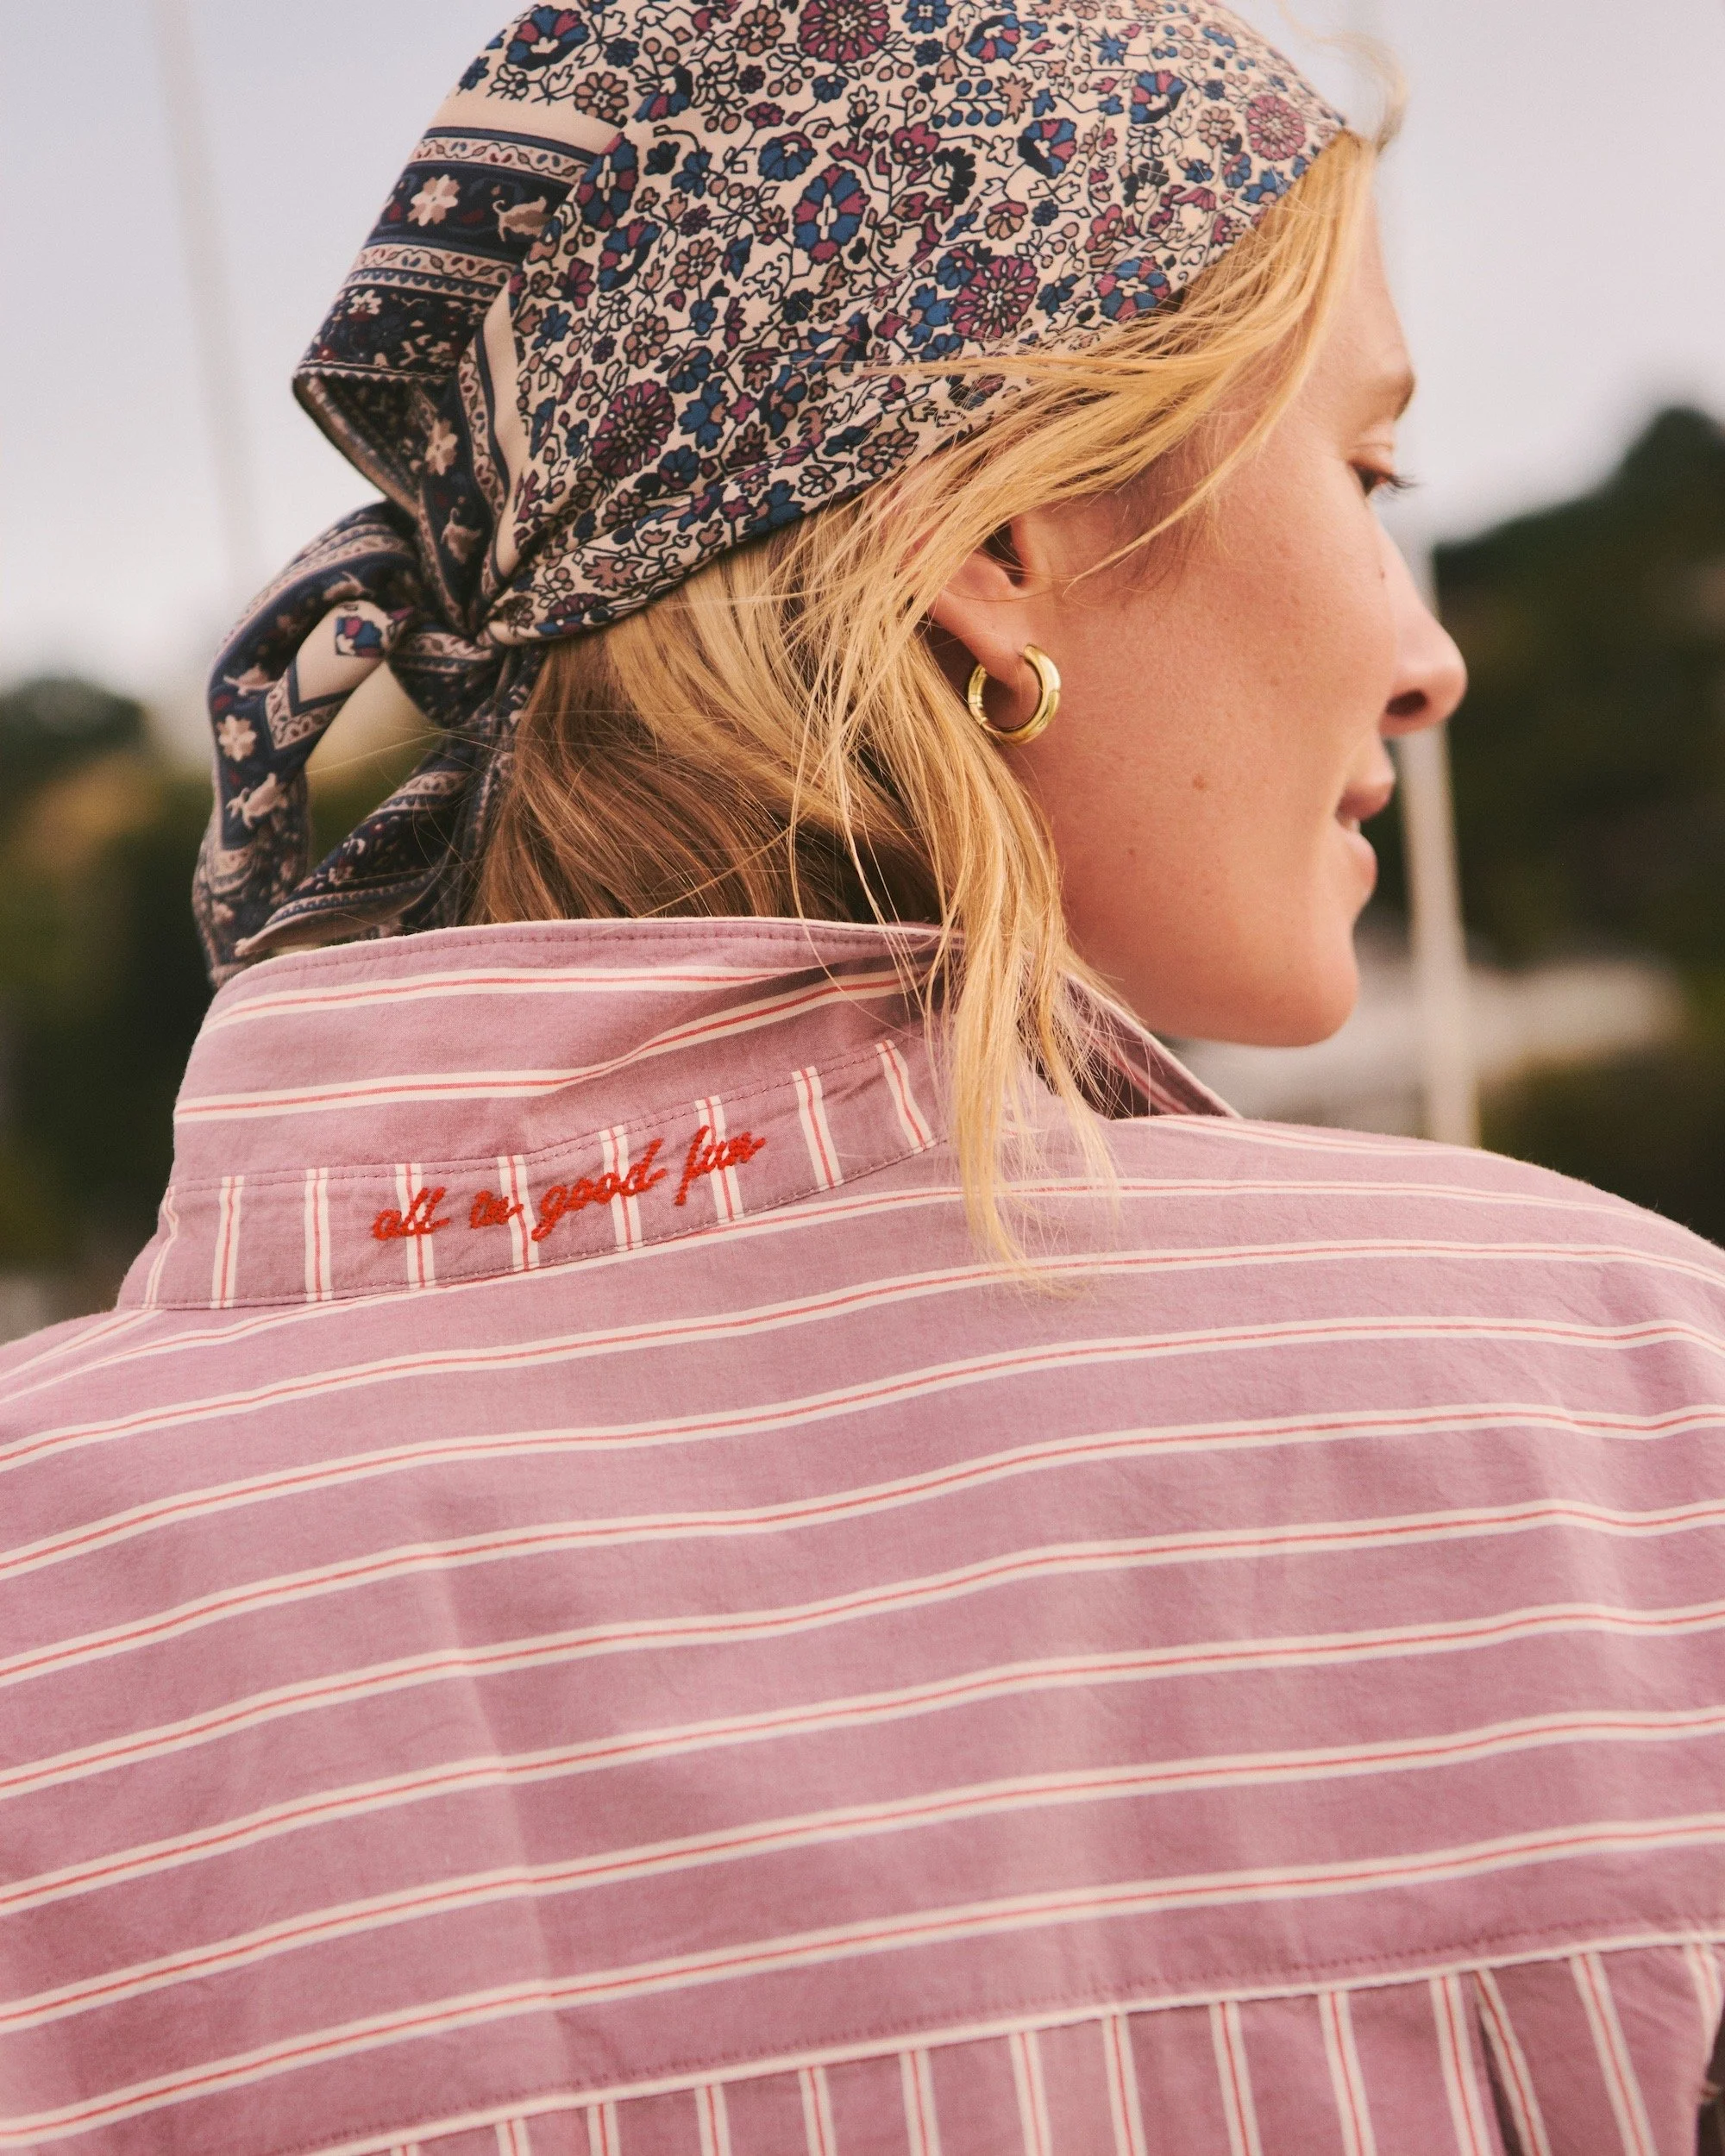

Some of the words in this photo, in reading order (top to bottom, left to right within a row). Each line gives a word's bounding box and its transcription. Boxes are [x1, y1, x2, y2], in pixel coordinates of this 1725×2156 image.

[372, 1186, 451, 1241] all
[530, 1138, 668, 1242] good
[674, 1125, 767, 1206] fun
